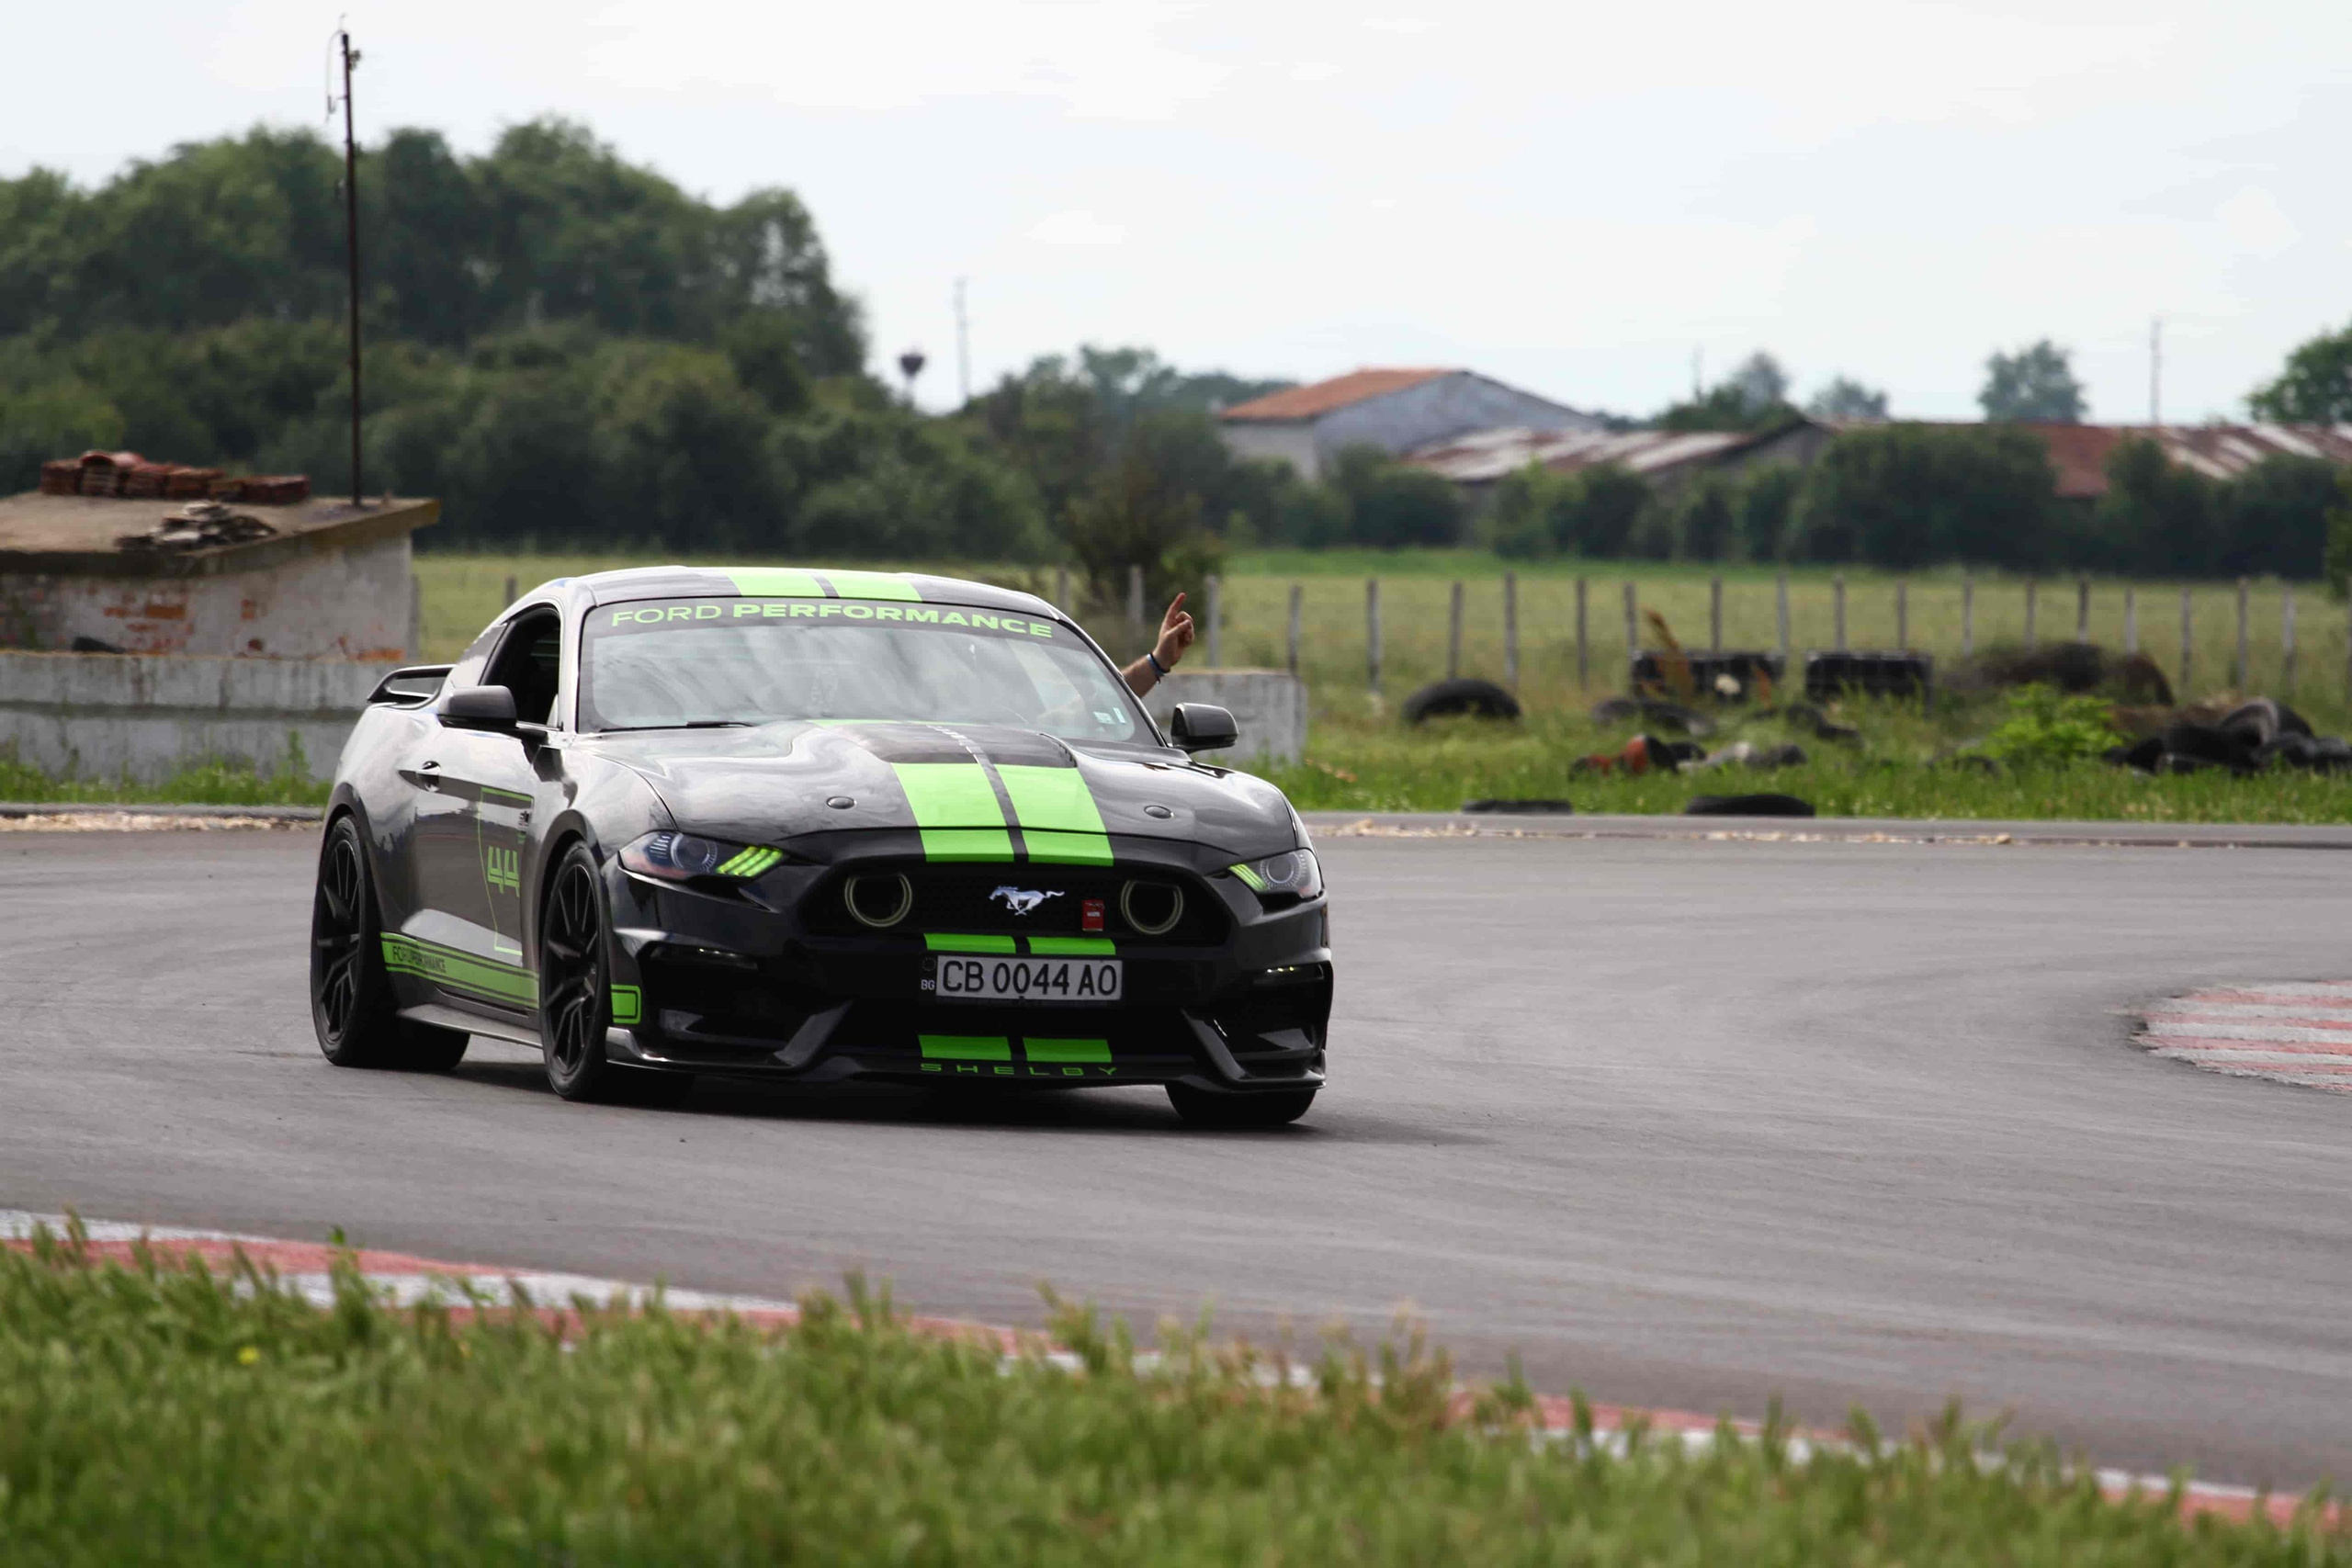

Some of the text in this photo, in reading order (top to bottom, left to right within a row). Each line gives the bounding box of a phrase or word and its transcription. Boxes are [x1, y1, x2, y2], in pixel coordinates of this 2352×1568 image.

[611, 603, 1053, 638] FORD PERFORMANCE
[487, 845, 520, 897] 44
[921, 979, 935, 990] BG
[943, 960, 1117, 996] CB 0044 AO
[920, 1063, 1118, 1077] SHELBY
